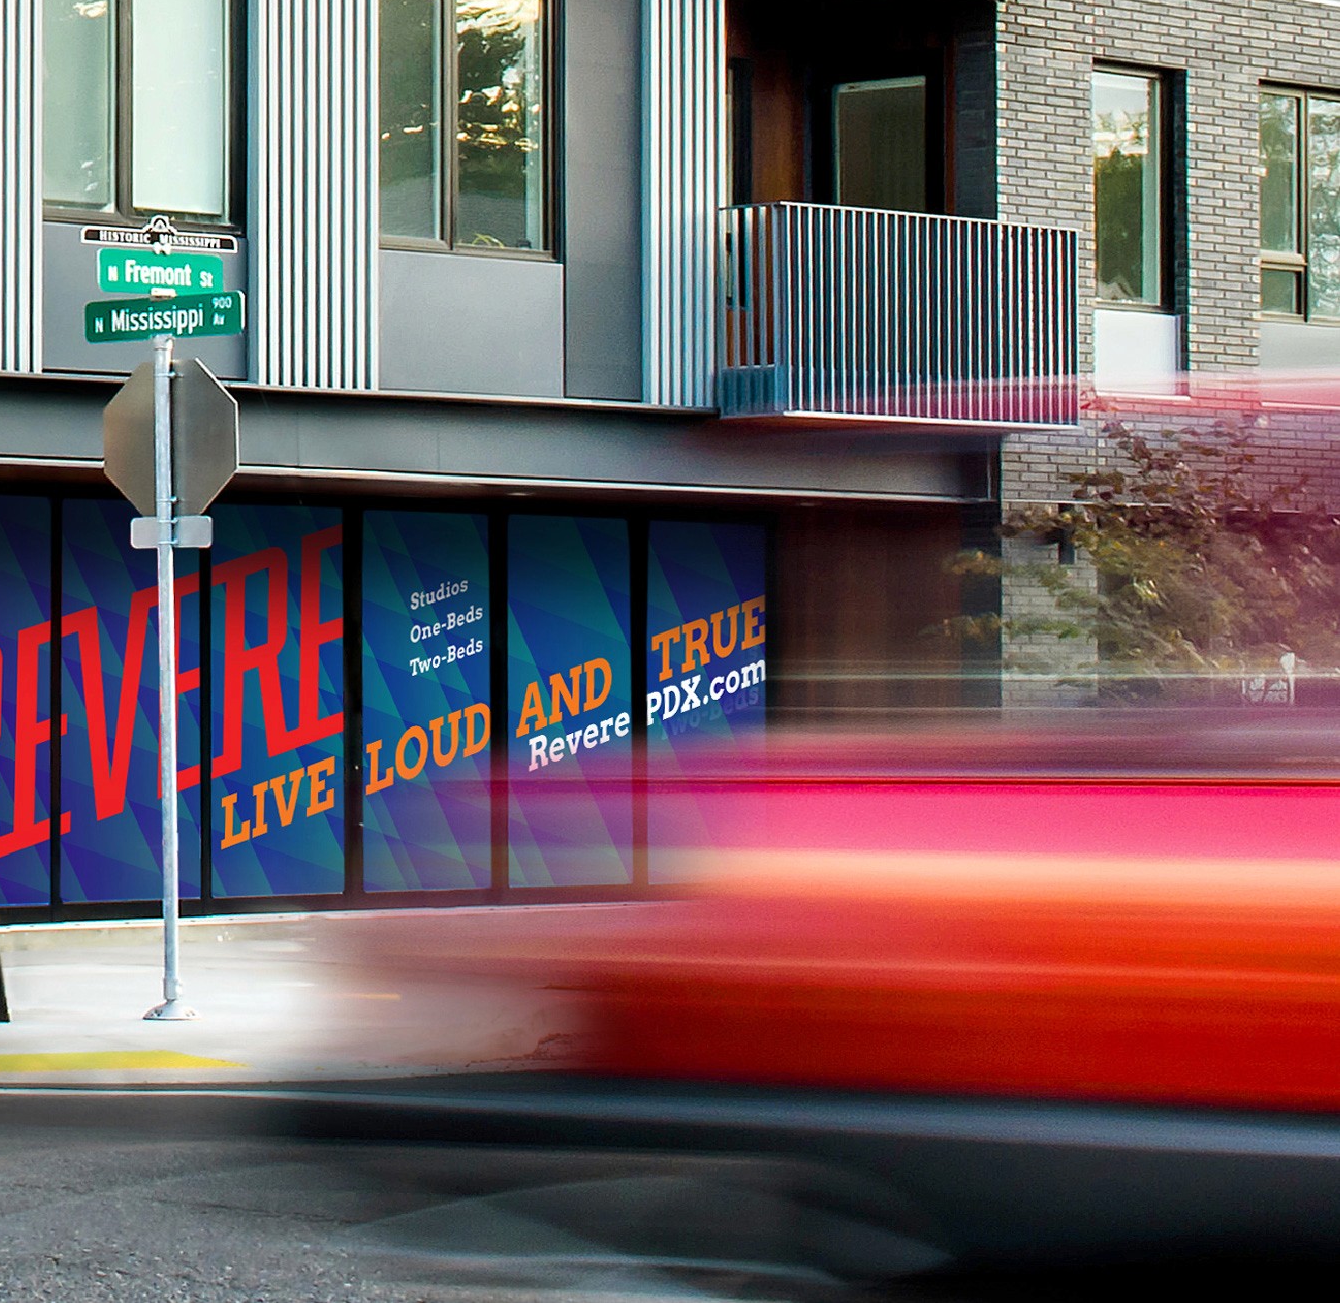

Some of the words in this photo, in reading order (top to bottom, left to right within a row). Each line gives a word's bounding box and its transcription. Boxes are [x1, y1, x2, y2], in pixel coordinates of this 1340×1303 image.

[99, 230, 151, 244] HISTORIC
[159, 232, 221, 249] MISSISSIPPI
[107, 265, 119, 282] N
[124, 259, 192, 286] Fremont
[199, 270, 214, 288] St
[212, 296, 232, 309] 900
[94, 316, 104, 334] N
[111, 303, 203, 335] Mississippi
[410, 579, 468, 610] Studios
[410, 605, 483, 644] One-Beds
[409, 637, 483, 677] Two-Beds
[220, 756, 335, 850] LIVE
[365, 703, 491, 795] LOUD
[516, 657, 613, 739] AND
[651, 594, 766, 682] TRUE
